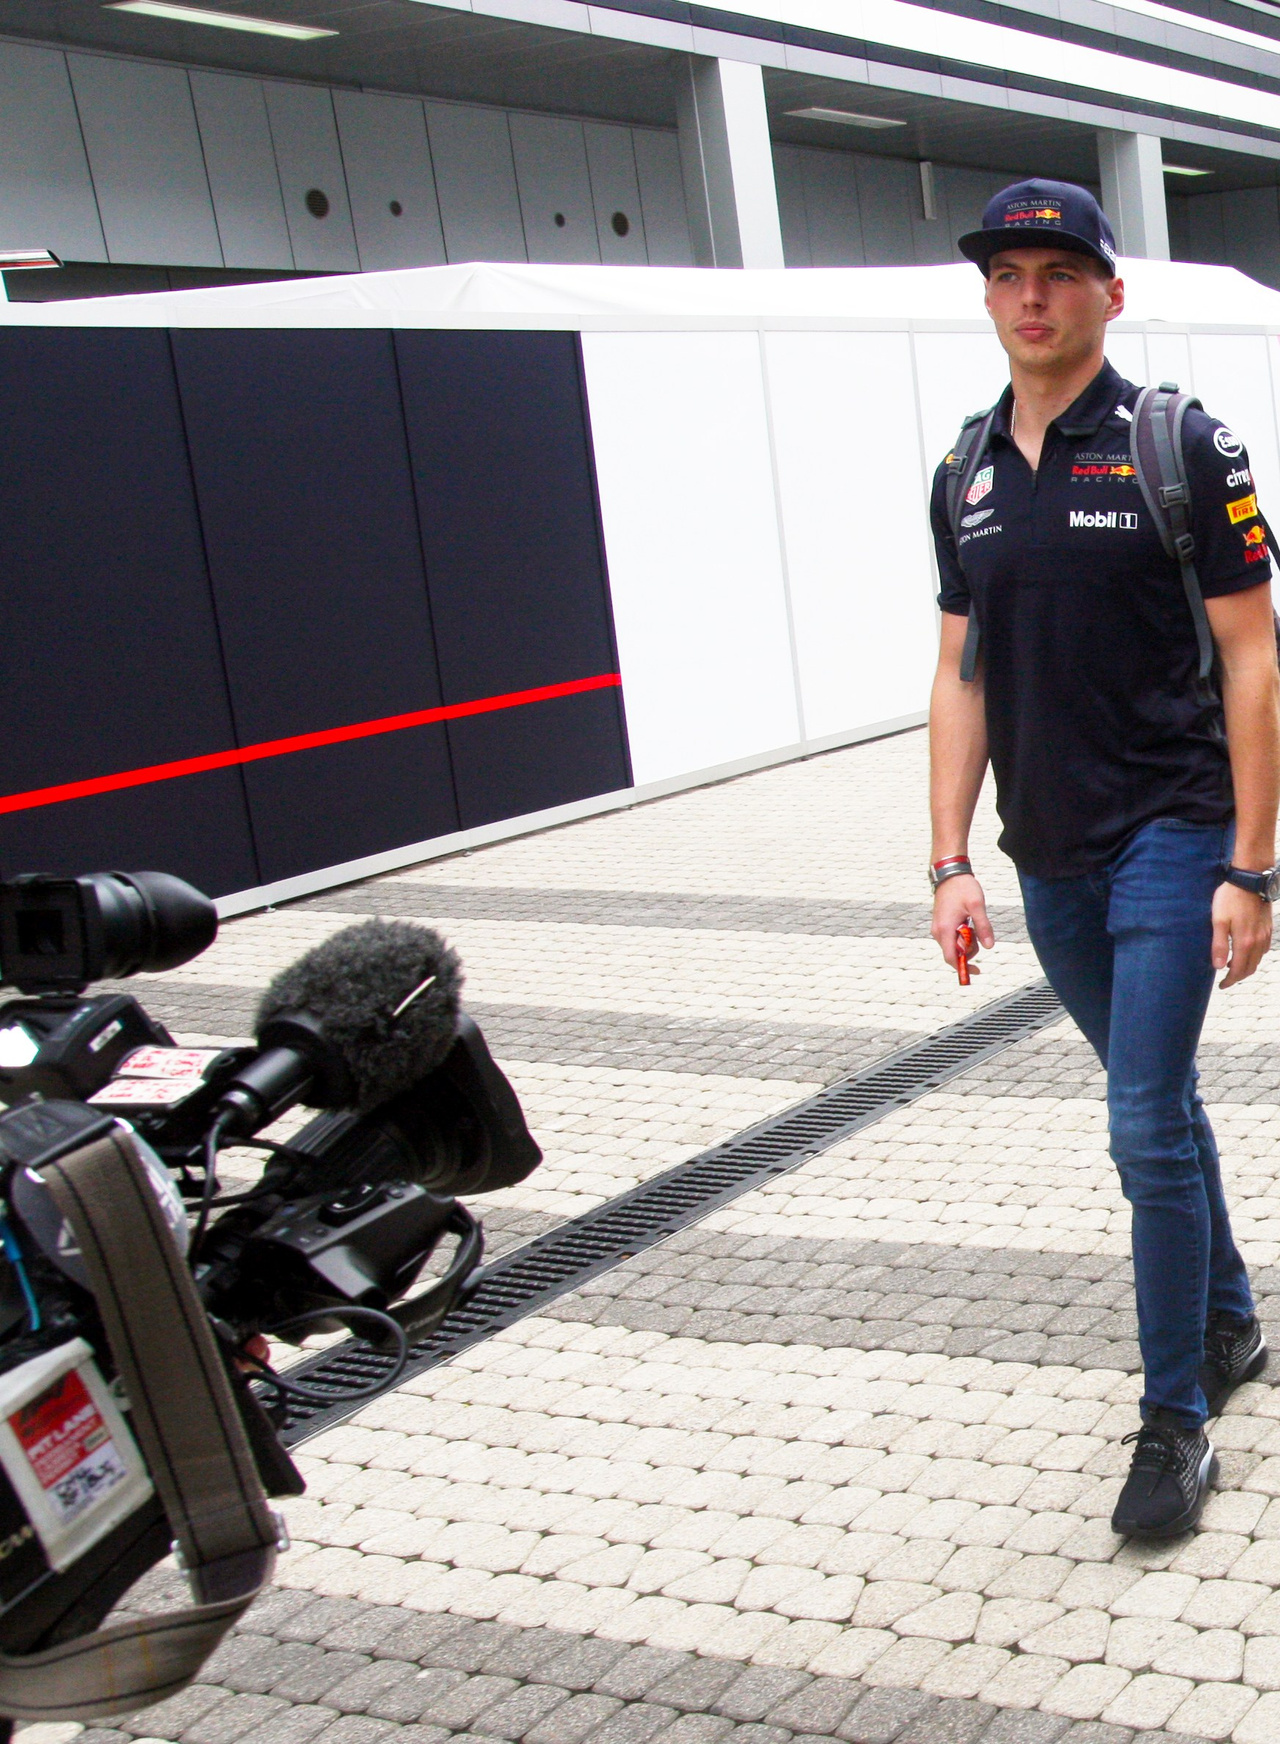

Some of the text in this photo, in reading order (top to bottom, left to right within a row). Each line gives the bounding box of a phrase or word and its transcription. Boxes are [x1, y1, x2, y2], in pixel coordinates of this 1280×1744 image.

[1006, 199, 1062, 210] ASTON MARTIN
[1004, 210, 1035, 222] Red Bull
[1004, 219, 1062, 228] RACING
[1074, 452, 1133, 462] ASTON MART
[1072, 465, 1109, 475] Red Bull
[1069, 510, 1117, 528] Mobil
[972, 524, 1003, 539] MARTIN
